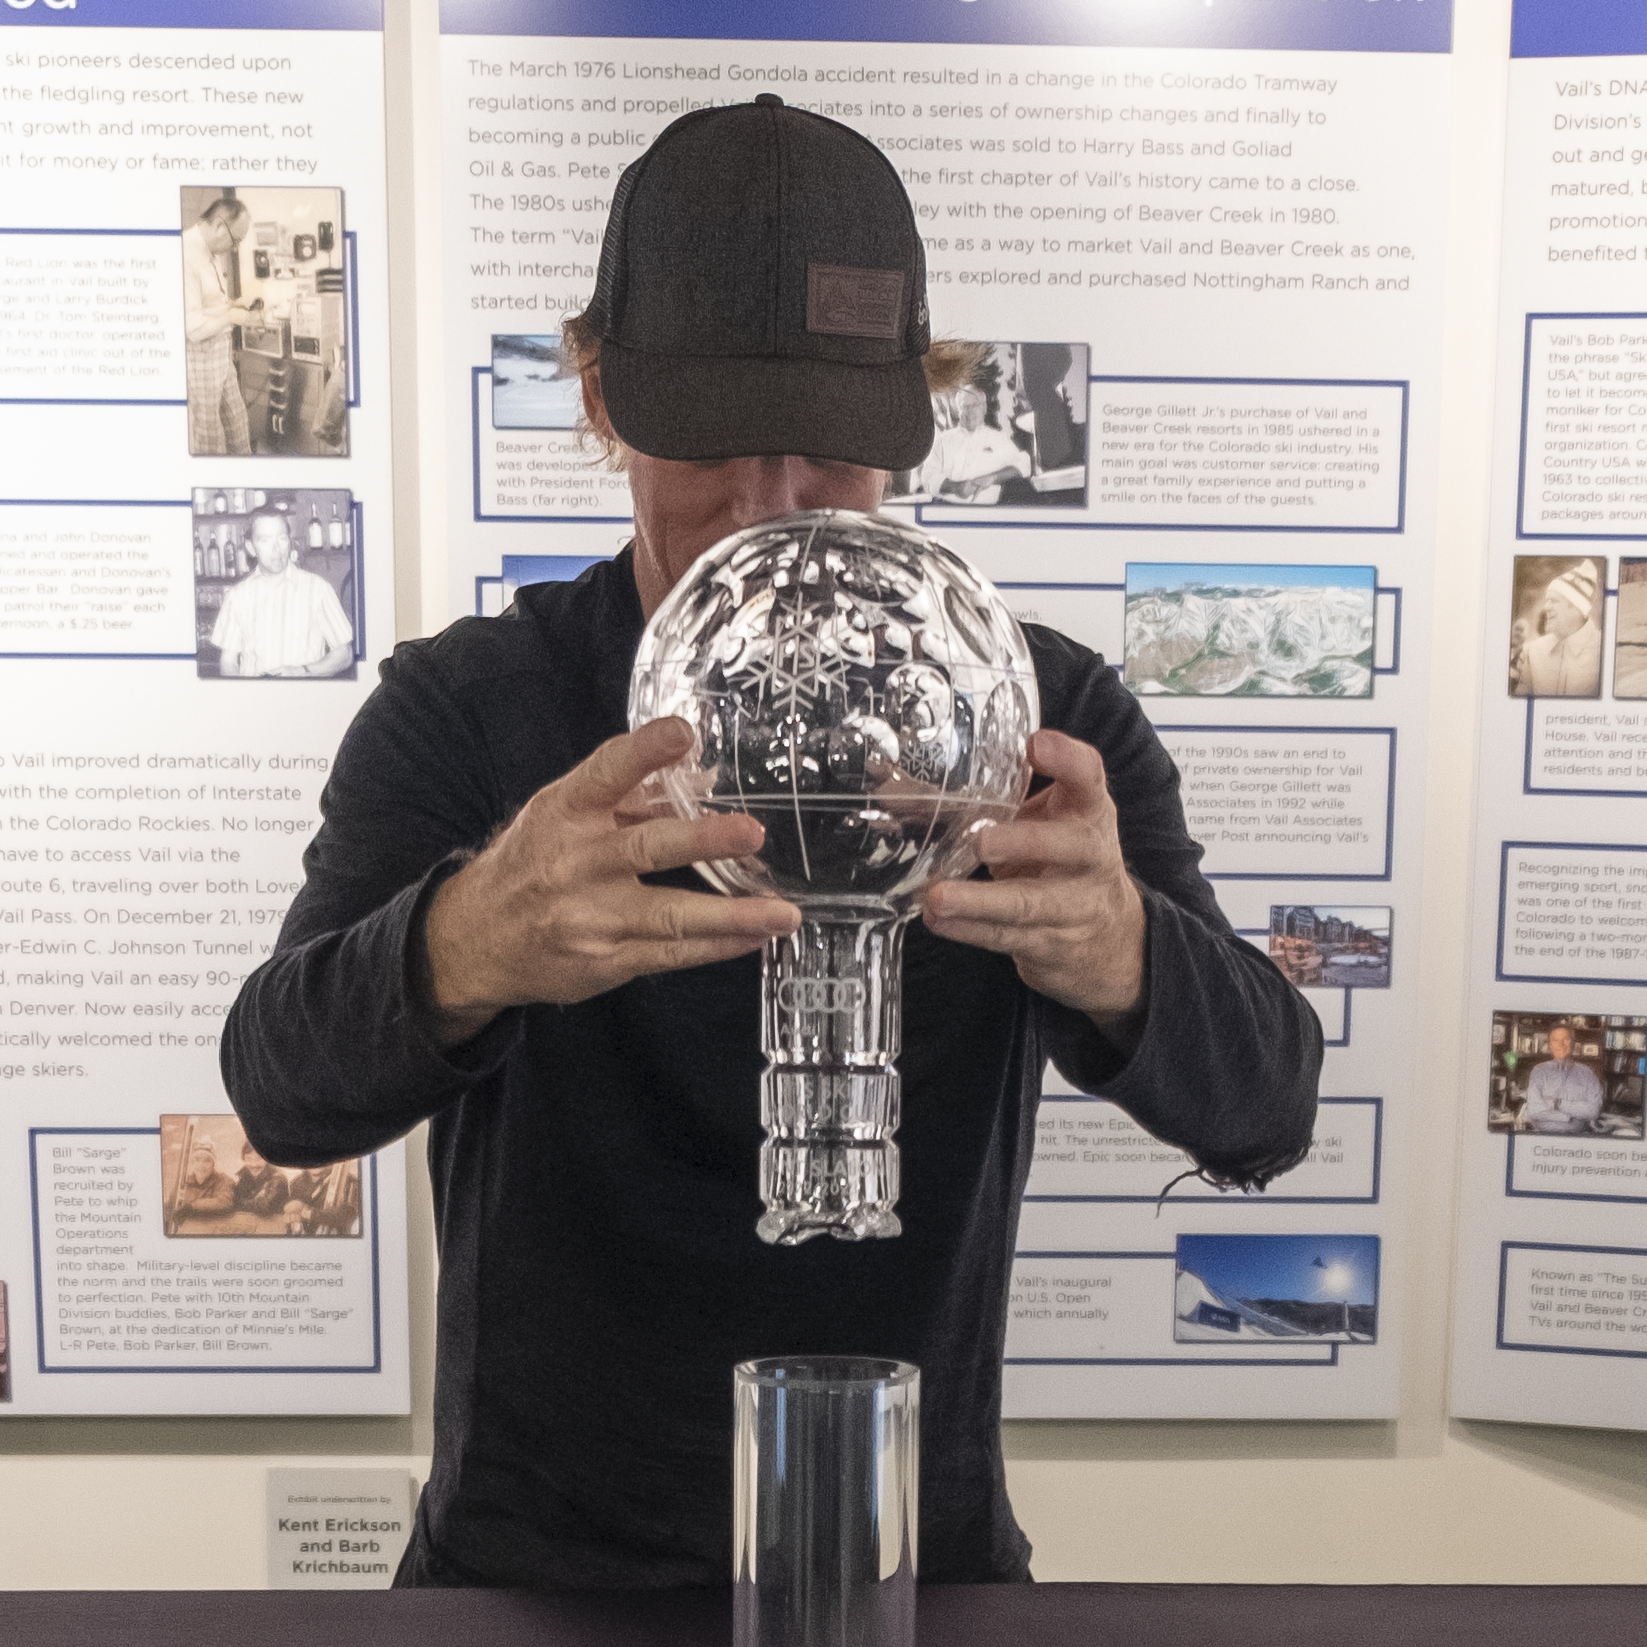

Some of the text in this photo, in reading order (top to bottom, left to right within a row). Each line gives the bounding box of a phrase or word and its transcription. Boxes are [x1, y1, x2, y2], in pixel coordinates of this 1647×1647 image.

[468, 59, 502, 76] The
[509, 61, 566, 77] March
[574, 61, 615, 78] 1976
[623, 63, 720, 80] Lionshead
[727, 64, 808, 81] Gondola
[814, 67, 894, 83] accident
[903, 69, 979, 84] resulted
[1008, 73, 1018, 85] a
[1255, 73, 1337, 95] Tramway
[1547, 244, 1637, 262] benefited
[1102, 403, 1367, 420] George Gillett Jr.'s purchase of Vail and
[12, 753, 44, 768] Vail
[51, 753, 140, 770] improved
[146, 753, 261, 772] dramatically
[267, 752, 329, 774] during
[31, 1062, 89, 1077] skiers.
[58, 1307, 353, 1321] Division buddies, Bob Parker and Bill "Sarge"
[278, 1518, 401, 1532] Kent Erickson
[299, 1539, 380, 1553] and Barb
[292, 1560, 388, 1573] Krichbaum
